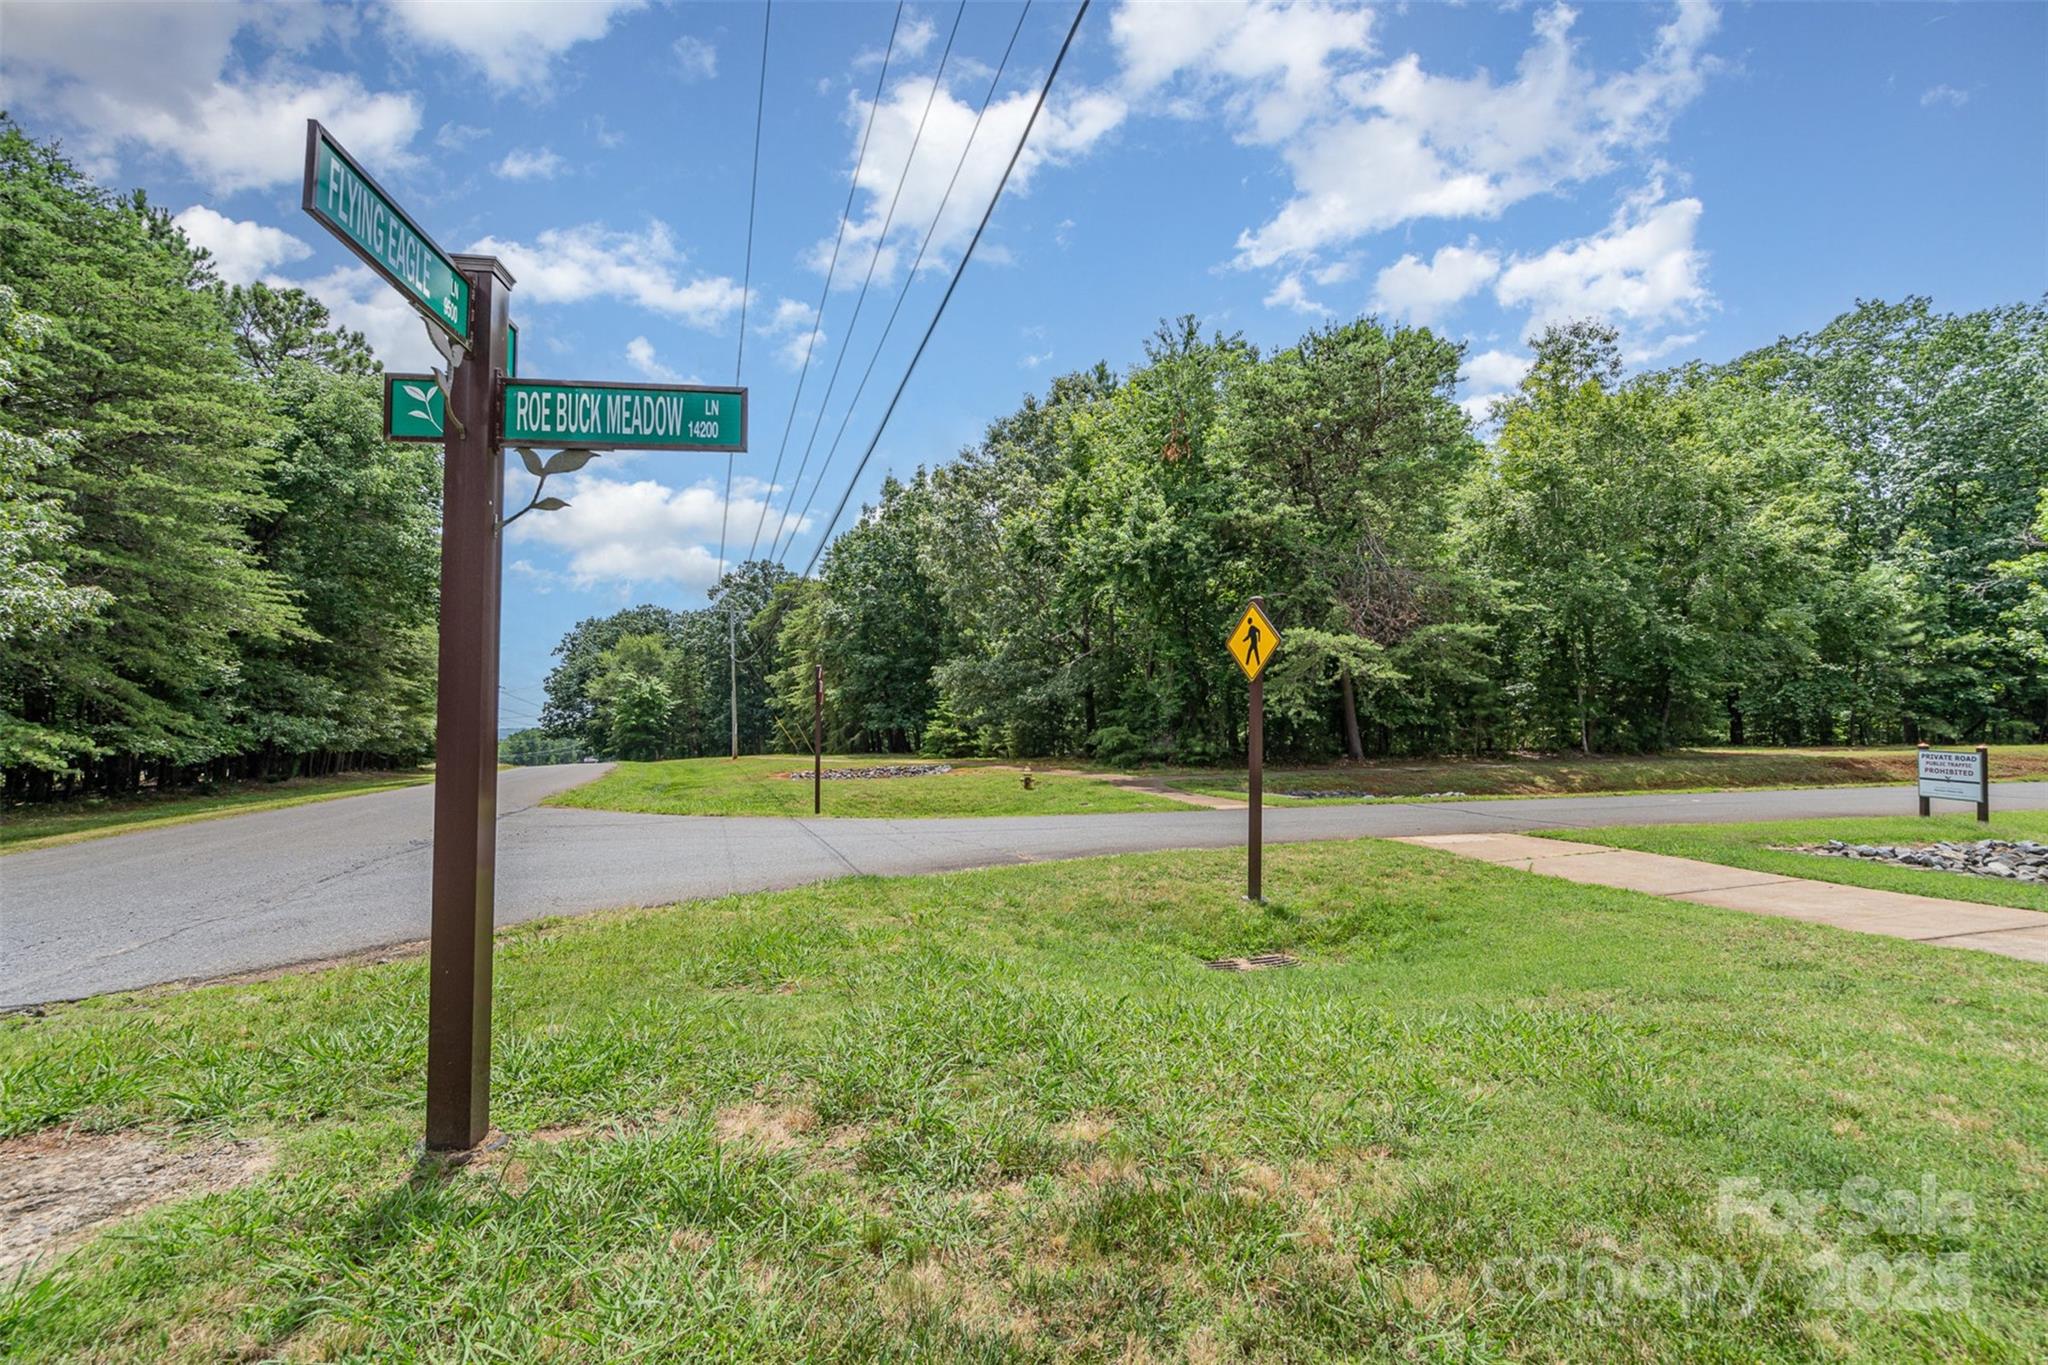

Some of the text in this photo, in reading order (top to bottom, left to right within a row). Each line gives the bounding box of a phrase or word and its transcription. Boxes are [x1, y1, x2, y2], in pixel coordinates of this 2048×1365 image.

[328, 157, 431, 299] FLYING EAGLE
[450, 278, 460, 301] LN
[517, 391, 684, 437] ROE BUCK MEADOW
[705, 399, 719, 416] LN
[688, 421, 719, 438] 14200
[1921, 753, 1952, 761] PRIVATE
[1924, 768, 1974, 776] PROHIBITED
